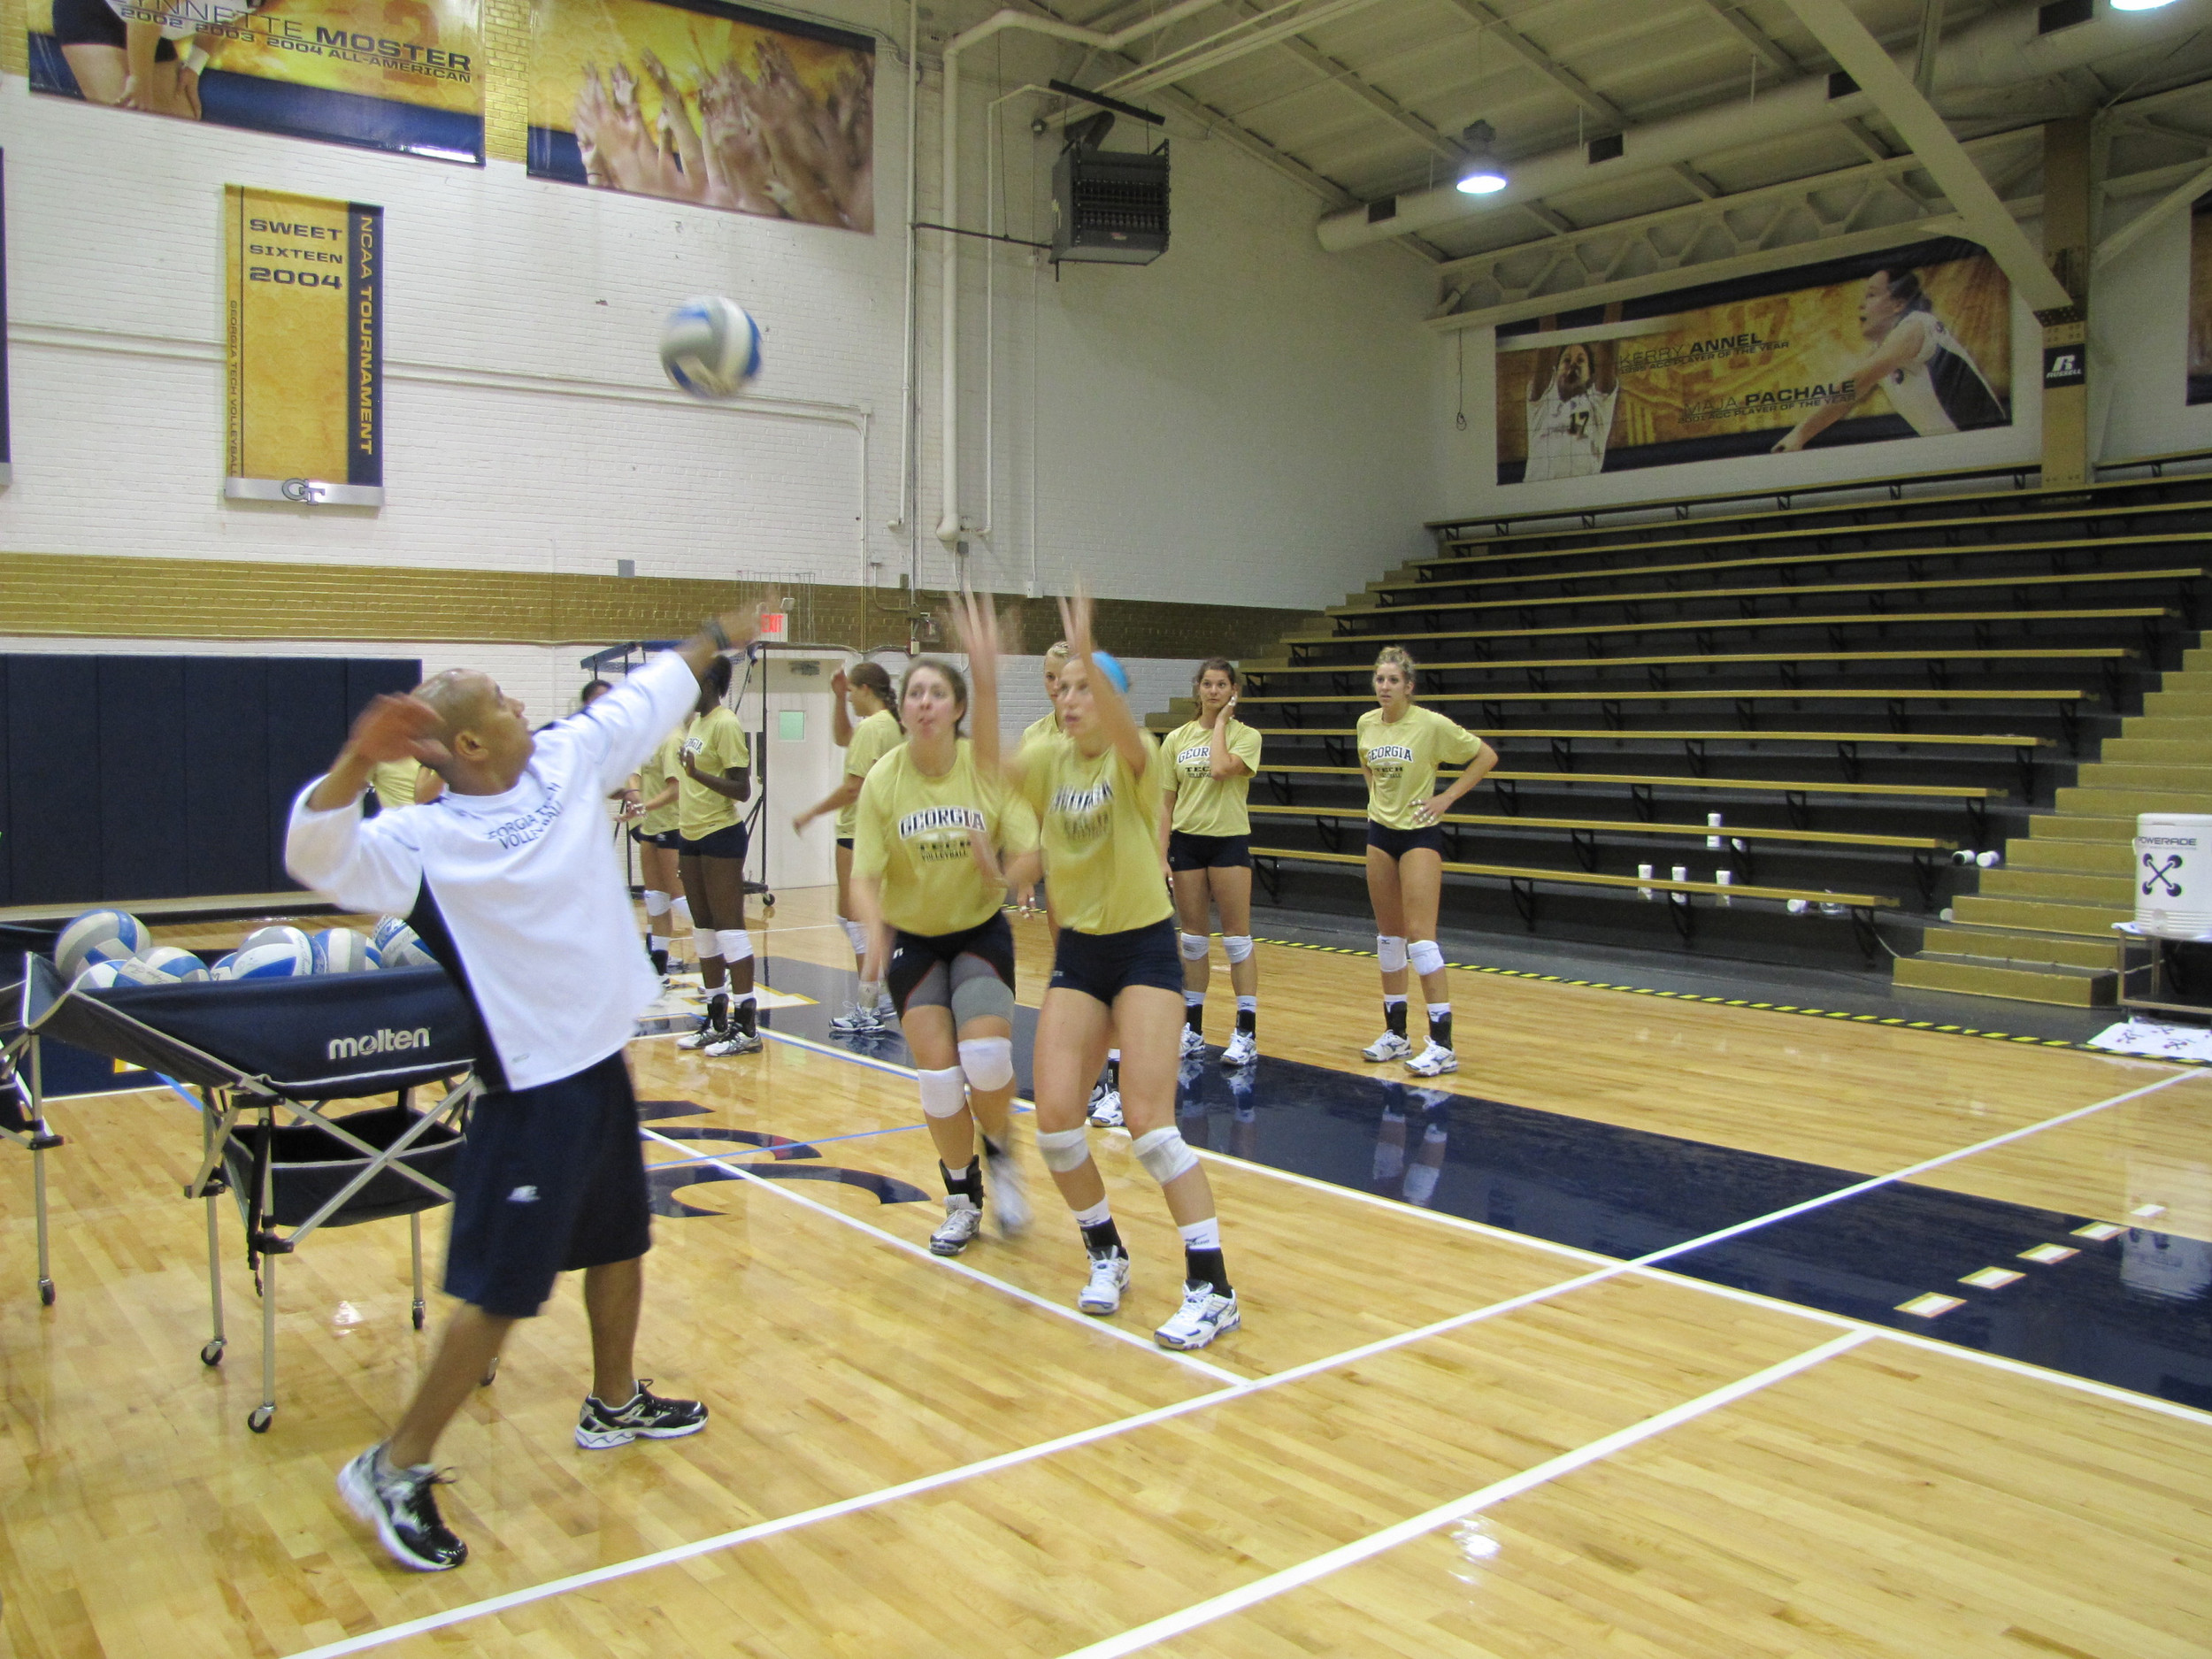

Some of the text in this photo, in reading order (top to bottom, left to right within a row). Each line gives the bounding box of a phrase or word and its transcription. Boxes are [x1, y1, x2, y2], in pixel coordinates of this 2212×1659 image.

[119, 0, 471, 71] NNETTE MOSTER
[121, 9, 471, 83] 2002 2003 2004 ALL-AMERICAN
[250, 219, 342, 241] SWEET
[250, 244, 342, 264] SIXTEEN
[250, 267, 342, 289] 2004
[359, 216, 373, 455] NCAA TOURNAMENT
[1761, 342, 1789, 351] YEAR
[1619, 333, 1763, 366] KERRY ANNEL
[1684, 380, 1855, 416] MAJA PACHALE
[1709, 411, 1732, 419] ACC
[1734, 406, 1777, 416] PLAYER
[762, 614, 783, 633] EXIT
[1178, 747, 1211, 763] GEOR
[1367, 746, 1412, 762] GEORGIA
[487, 814, 539, 841] EORGIA
[900, 806, 986, 838] GEORGIA
[2139, 836, 2197, 846] POWERADE
[328, 1027, 431, 1060] molten
